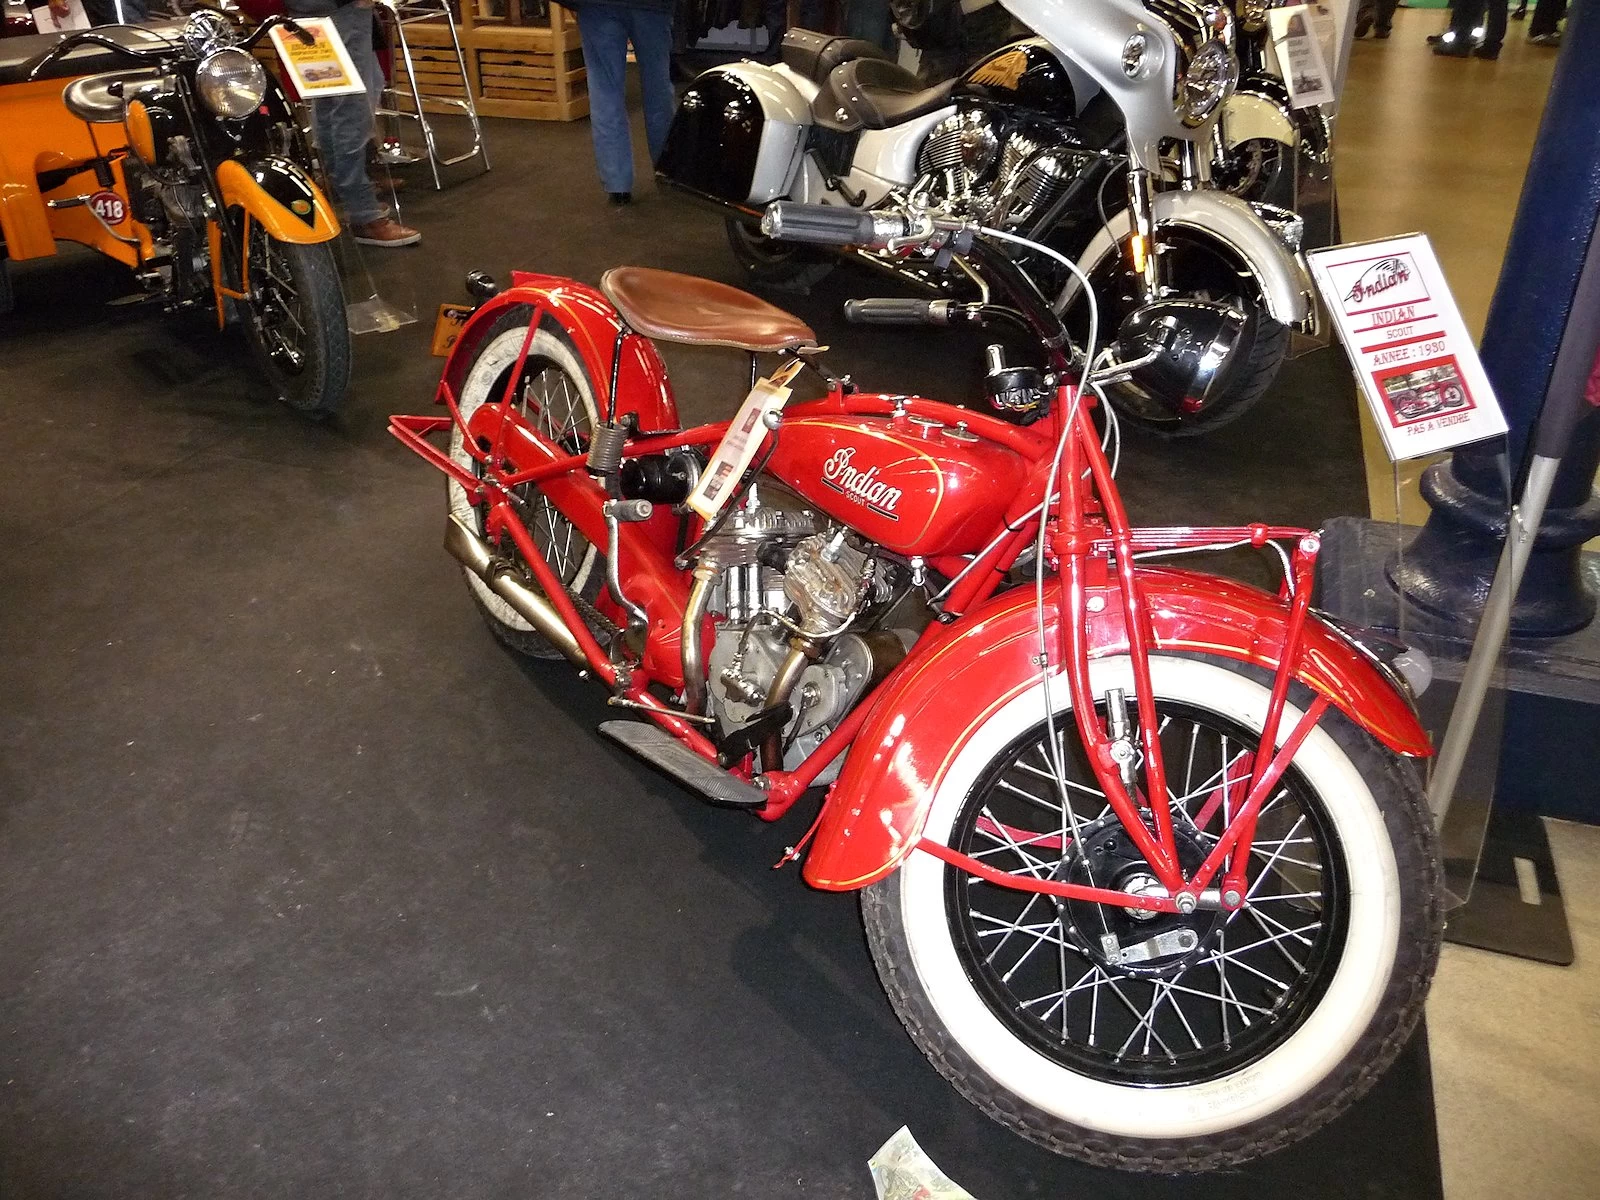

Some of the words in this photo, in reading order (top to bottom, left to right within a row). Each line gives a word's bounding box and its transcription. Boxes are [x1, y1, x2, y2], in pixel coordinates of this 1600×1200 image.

[95, 199, 124, 219] 418
[1352, 269, 1410, 303] Indian
[1371, 305, 1416, 327] INDIAN
[1386, 325, 1414, 340] SCOUT
[1406, 423, 1426, 436] PAS
[1436, 411, 1471, 428] VENDRE
[823, 447, 903, 511] Indian
[845, 490, 866, 507] SCOUT
